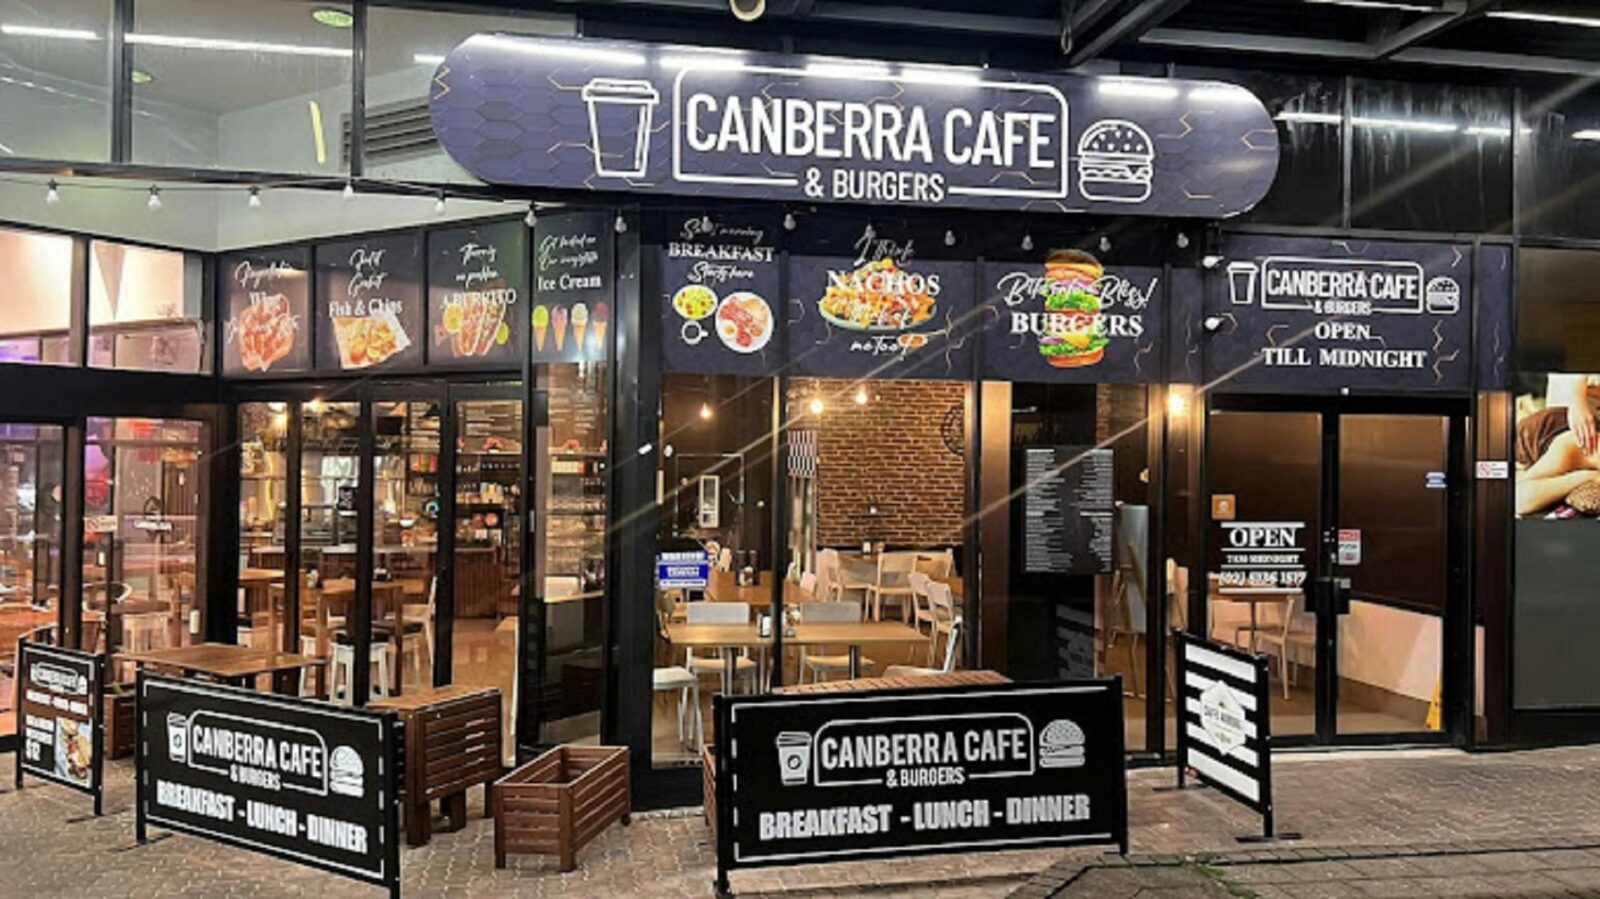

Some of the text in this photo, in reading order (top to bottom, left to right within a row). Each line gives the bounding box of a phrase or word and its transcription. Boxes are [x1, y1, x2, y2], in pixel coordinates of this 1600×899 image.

[685, 92, 1057, 169] CANBERRA CAFE
[804, 170, 945, 203] & BURGERS
[668, 242, 775, 263] BREAKFAST
[538, 272, 602, 292] Ice Cream
[825, 269, 941, 296] NACHOS
[1267, 269, 1419, 300] CANBERRA CAFE
[328, 297, 403, 318] Fish & Chips
[1313, 300, 1373, 316] & BURGERS
[1010, 311, 1145, 337] BURGERS
[1314, 321, 1371, 340] OPEN
[1262, 347, 1428, 369] TILL MIDNIGHT
[1229, 528, 1297, 547] OPEN
[193, 724, 323, 779] CANBERRA CAFE
[822, 728, 1028, 769] CANBERRA CAFE
[229, 765, 282, 792] & BURGERS
[886, 767, 965, 788] & BURGERS
[156, 779, 236, 823] BREAKFAST
[246, 801, 298, 838] LUNCH
[307, 813, 368, 855] DINNER
[759, 804, 892, 841] BREAKFAST
[913, 800, 990, 831] LUNCH
[1006, 794, 1090, 825] DINNER
